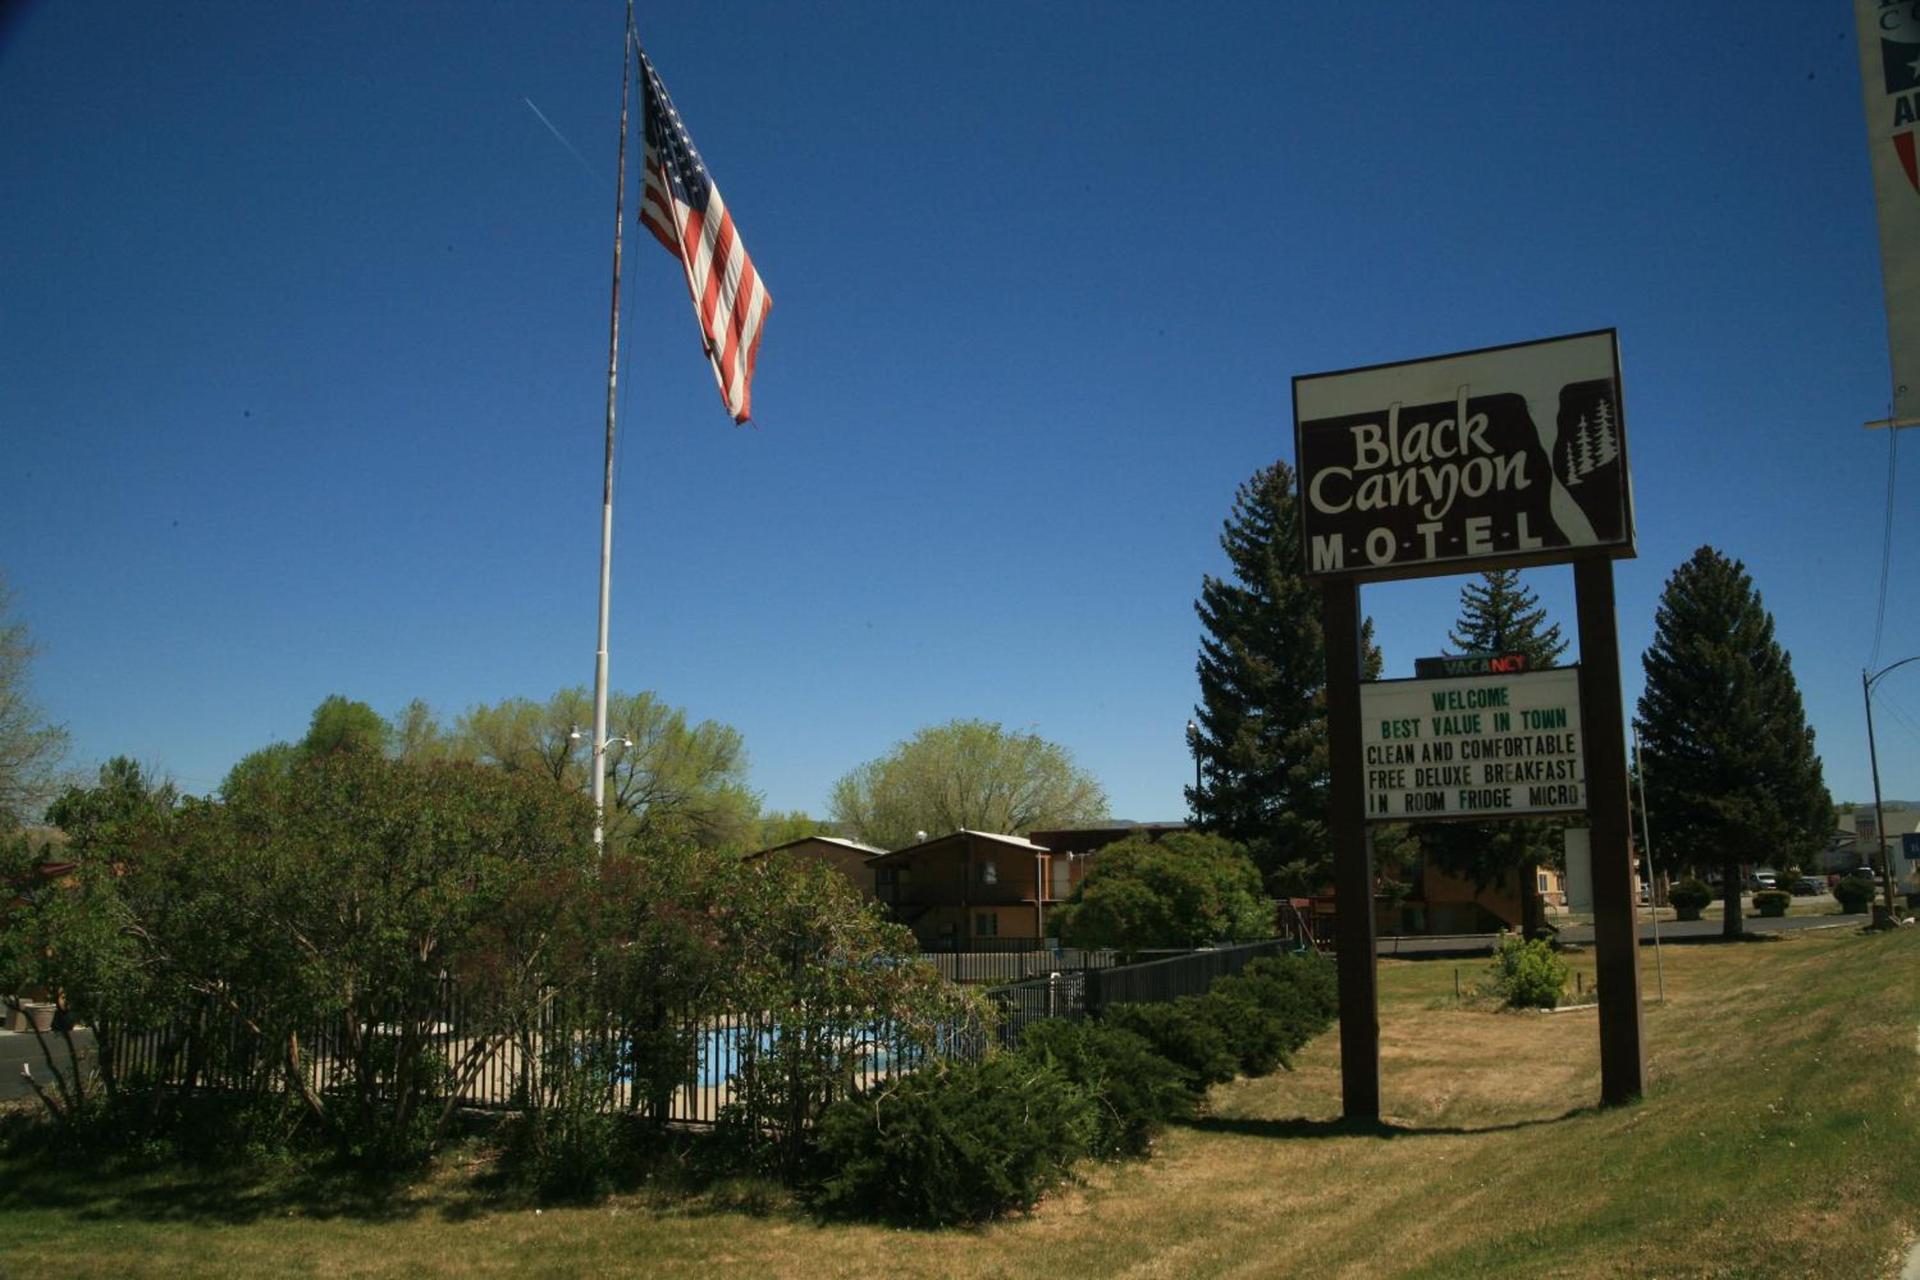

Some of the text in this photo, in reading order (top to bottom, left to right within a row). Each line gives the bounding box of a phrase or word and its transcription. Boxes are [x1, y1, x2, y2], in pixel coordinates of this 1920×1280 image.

[1350, 384, 1495, 471] Black
[1309, 450, 1532, 520] Canyon
[1443, 655, 1526, 674] VACANCY
[1432, 687, 1509, 711] WELCOME
[1381, 708, 1567, 739] BEST VALUE IN TOWN
[1367, 734, 1575, 765] CLEAN AND COMFORTABLE
[1369, 760, 1577, 790] FREE DELUXE BREAKFAST
[1370, 784, 1578, 813] IN ROOM FRIDGE MICRO
